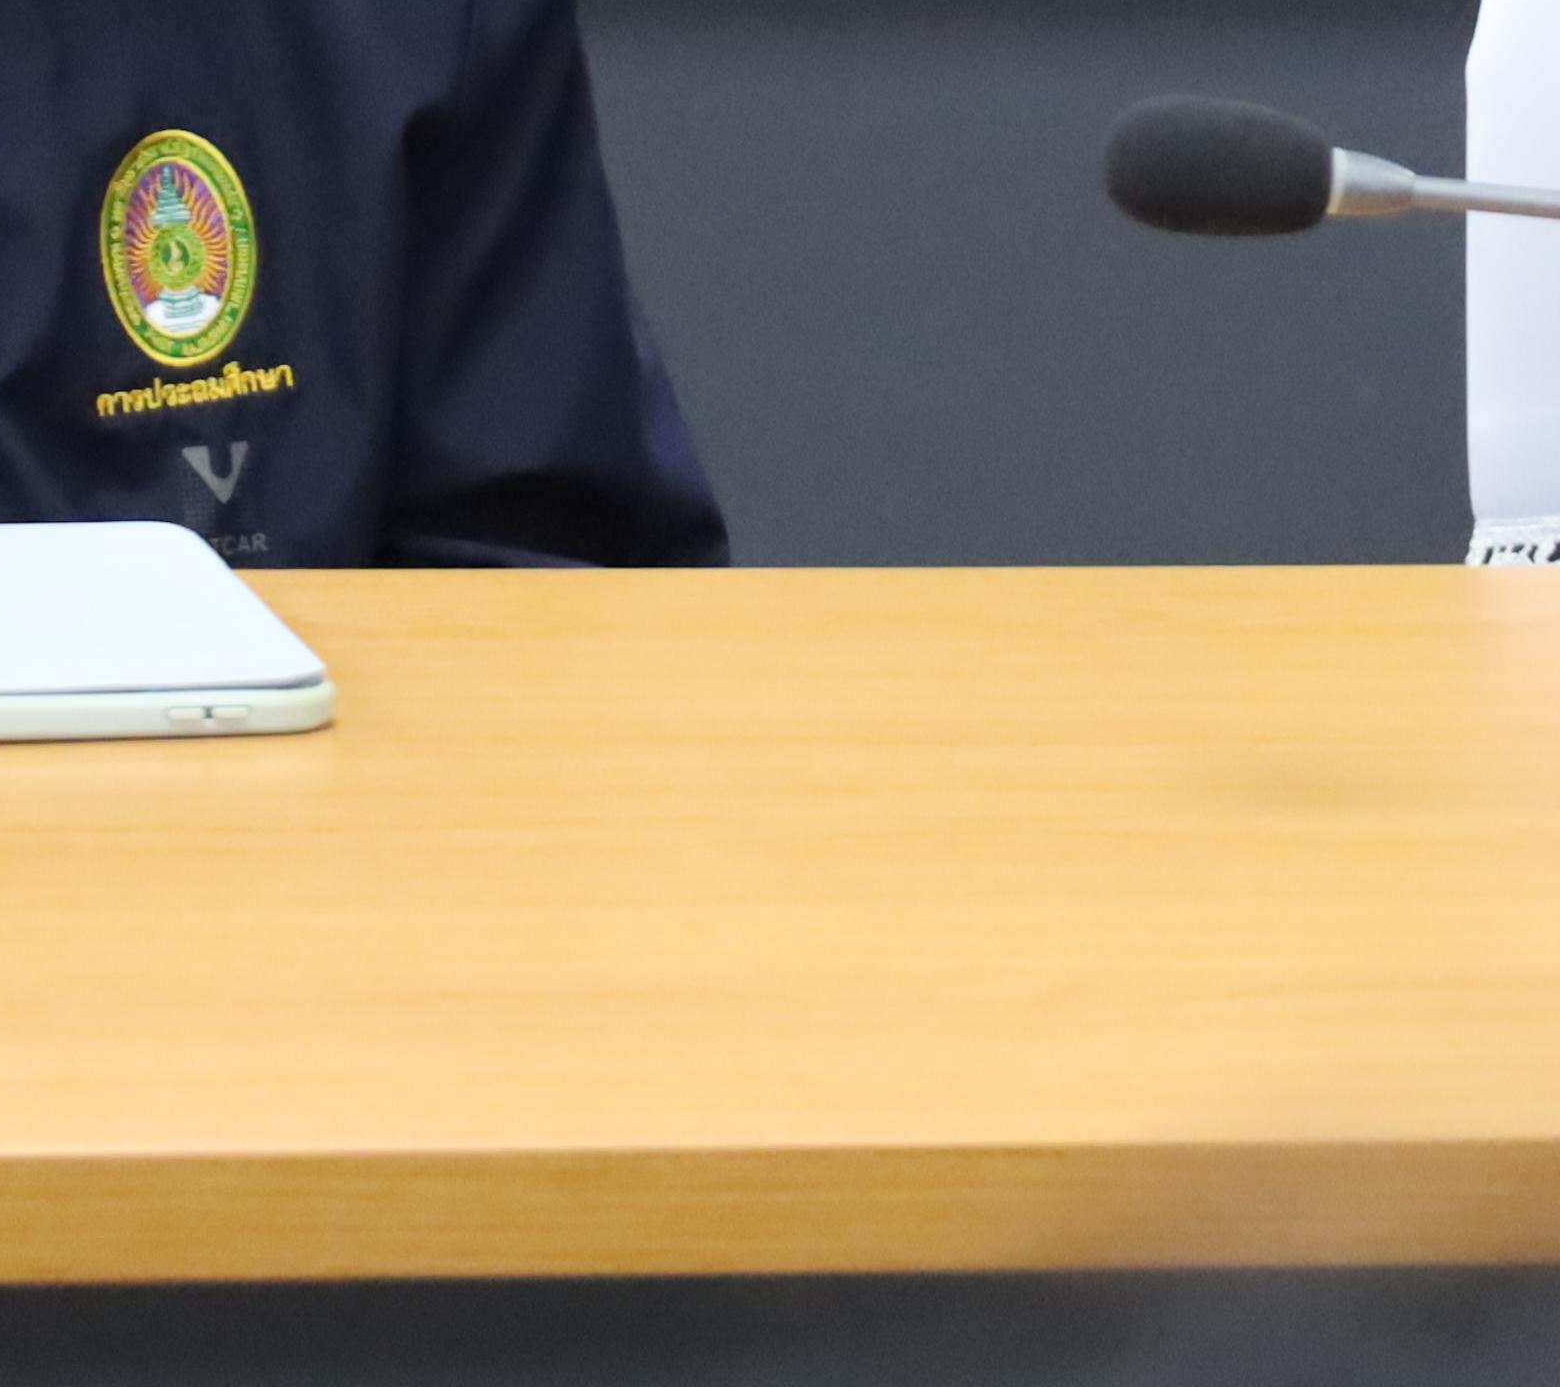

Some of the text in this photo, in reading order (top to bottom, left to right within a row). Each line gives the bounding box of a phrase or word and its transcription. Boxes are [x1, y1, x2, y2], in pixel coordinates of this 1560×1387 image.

[96, 360, 294, 417] การประถมศึกษา
